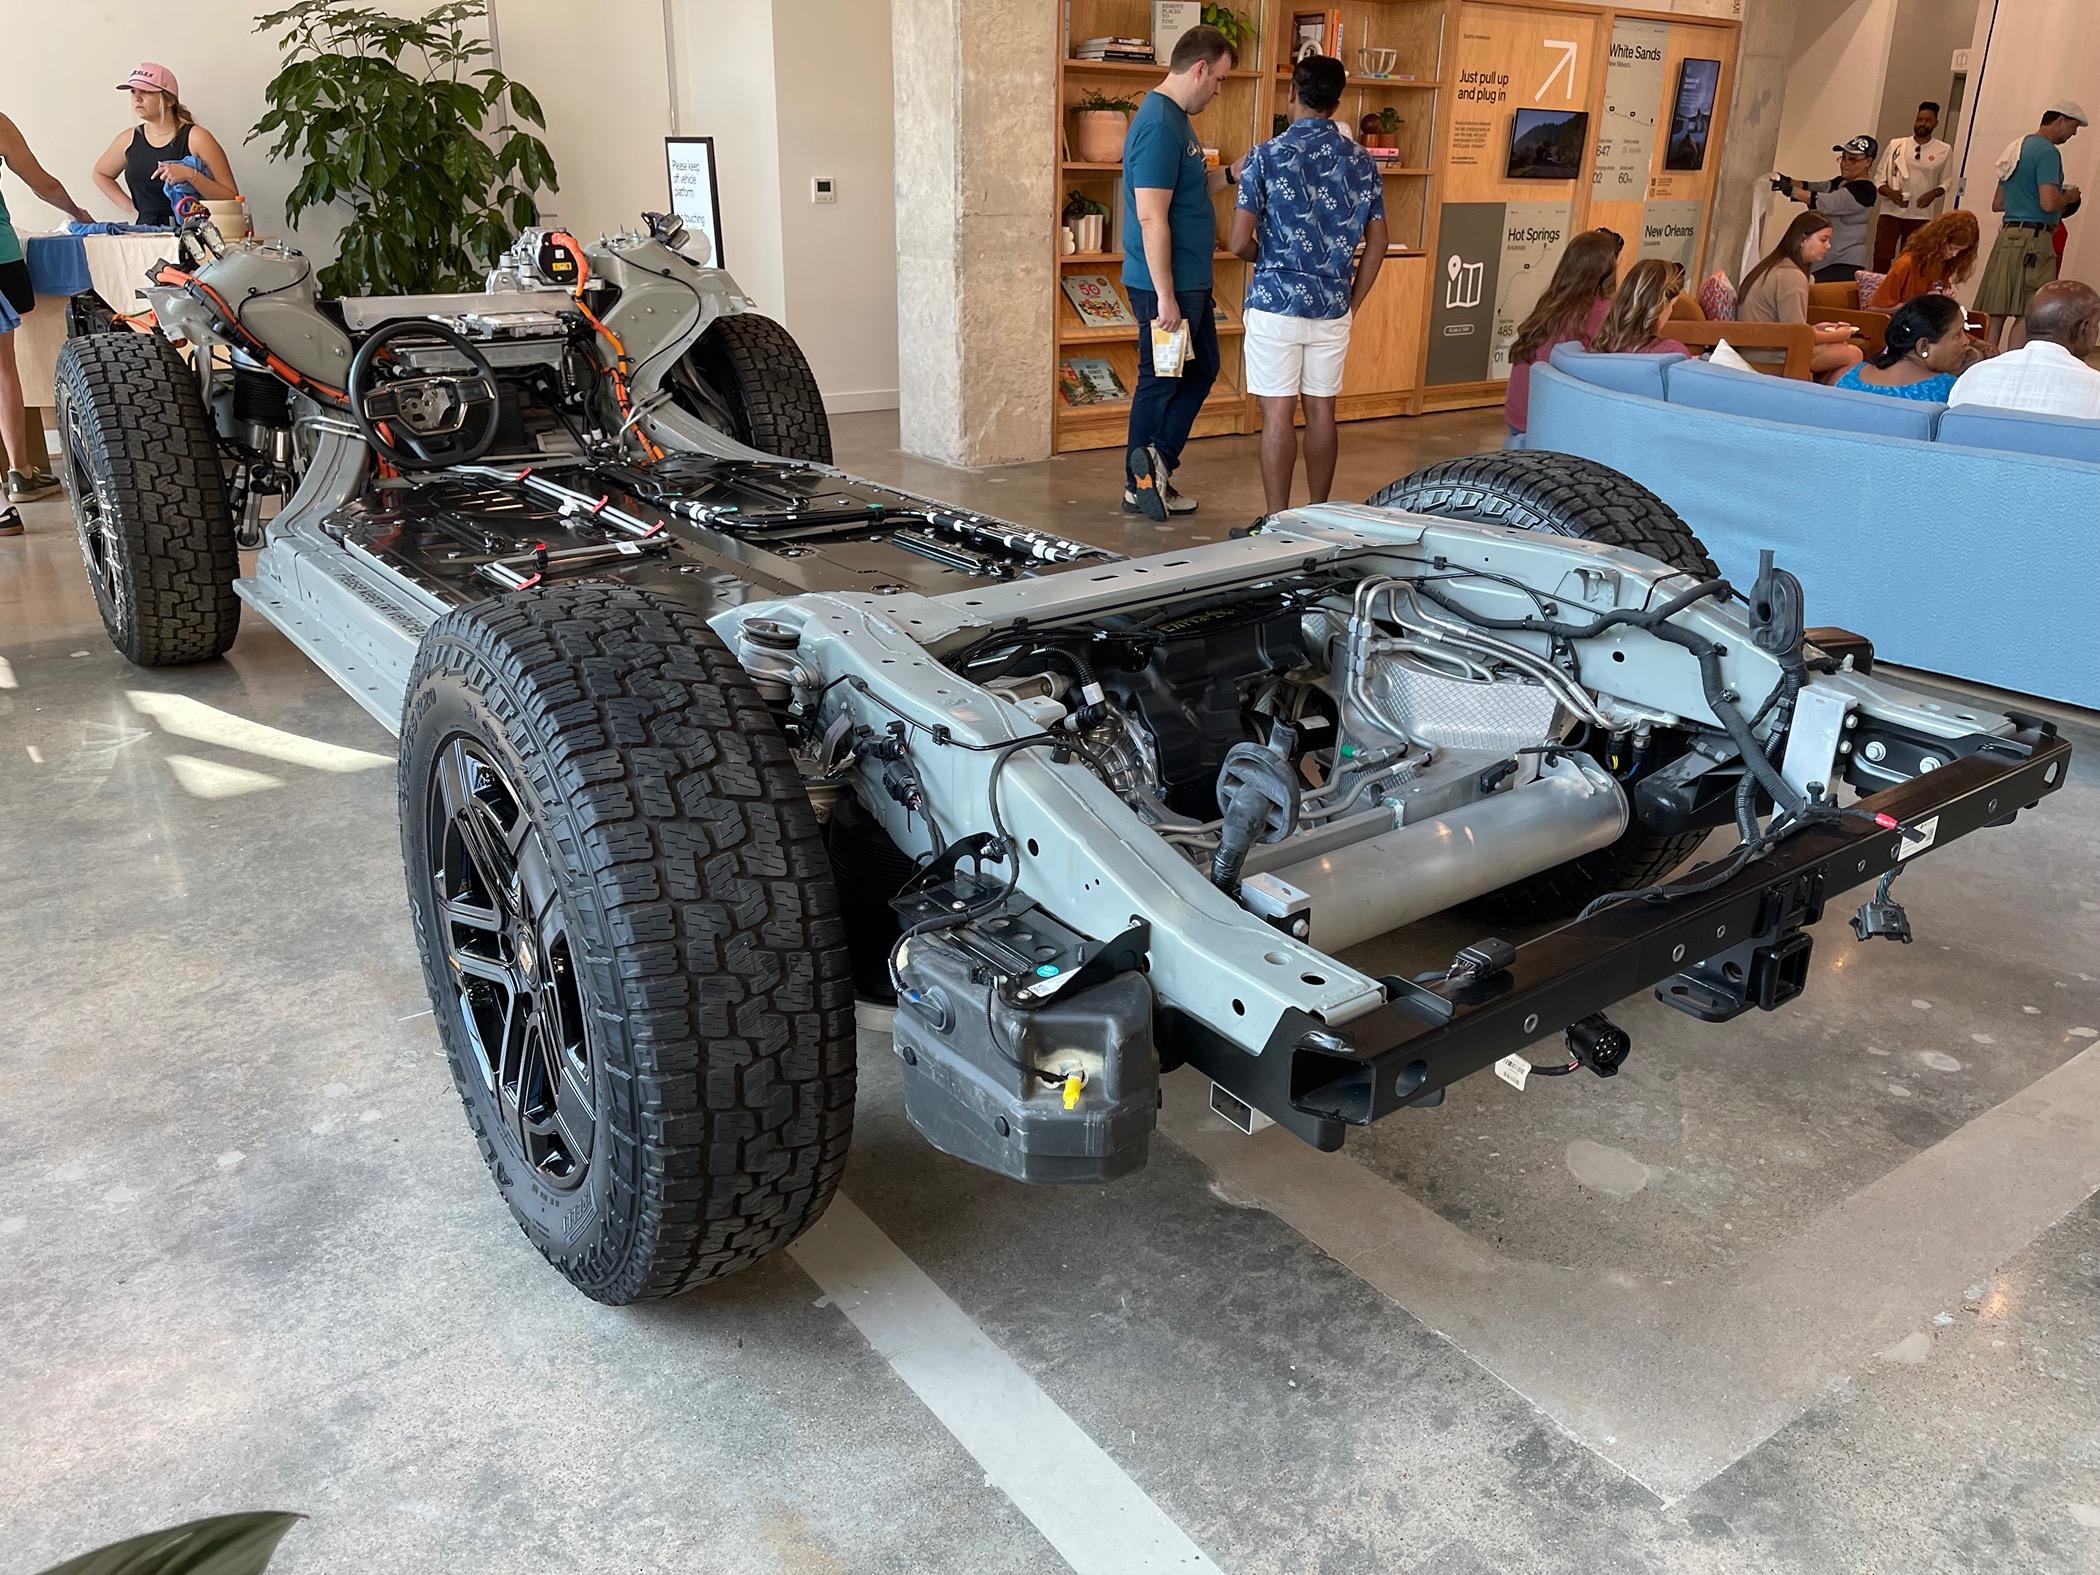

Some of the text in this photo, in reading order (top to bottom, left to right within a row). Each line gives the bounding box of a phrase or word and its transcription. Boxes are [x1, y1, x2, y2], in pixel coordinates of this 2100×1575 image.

[1609, 43, 1662, 61] White Sands
[1459, 69, 1509, 88] Just pull up
[1457, 86, 1506, 104] and plug in
[1596, 145, 1611, 157] 647
[1508, 227, 1561, 243] Hot Springs
[1644, 224, 1695, 238] New Orleans
[1078, 283, 1102, 296] 50
[1497, 325, 1514, 337] 485
[1494, 351, 1504, 363] 01
